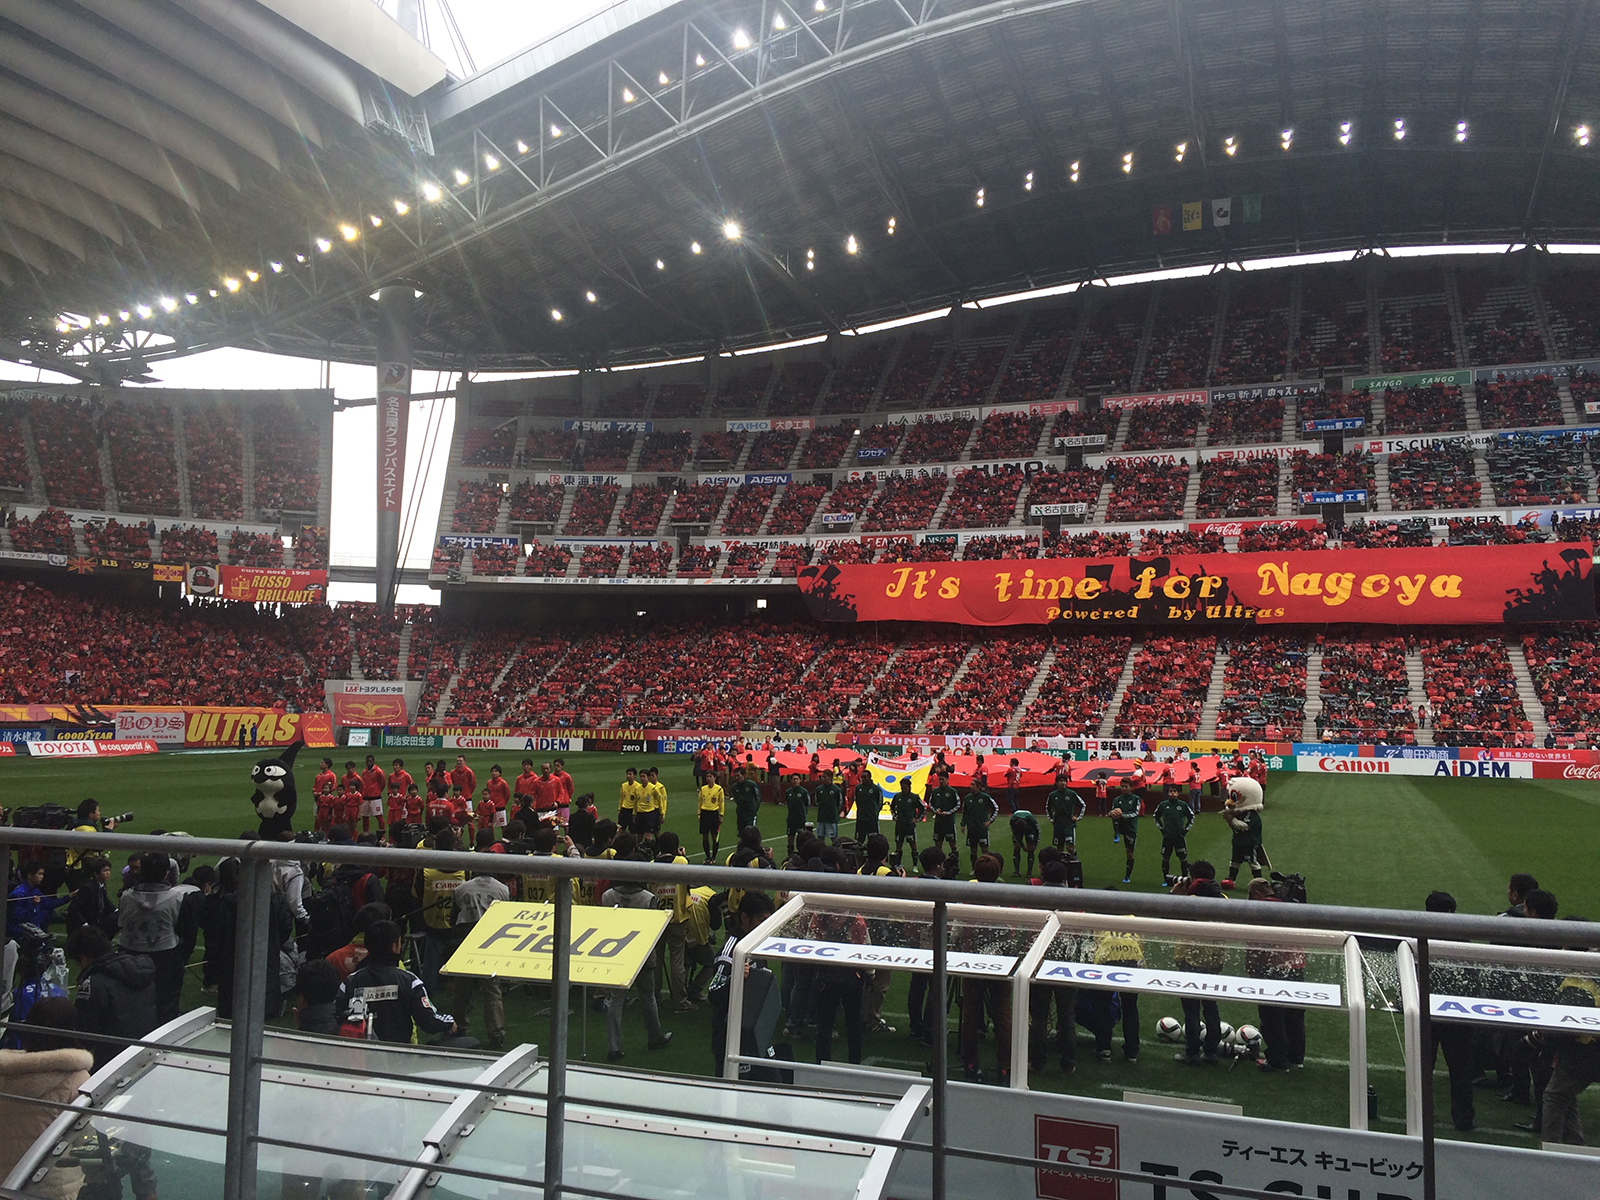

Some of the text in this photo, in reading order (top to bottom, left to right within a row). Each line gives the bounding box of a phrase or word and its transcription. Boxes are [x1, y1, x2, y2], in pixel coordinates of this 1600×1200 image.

[1370, 375, 1455, 389] SANGO SANGO
[571, 421, 611, 431] ASMO
[616, 421, 646, 431] アスモ
[728, 421, 768, 431] TAIHO
[1066, 435, 1105, 446] 名古屋銀行
[1386, 441, 1404, 452] TS
[383, 396, 399, 507] 名古屋グランパスエイト
[564, 475, 618, 487] 東海理化
[702, 476, 741, 487] AISIN
[750, 475, 789, 486] AISIN
[1043, 503, 1085, 514] 名古屋銀行
[823, 514, 854, 523] EXEDY
[1205, 521, 1242, 536] Coca-Cola
[444, 537, 513, 549] アサヒビール
[101, 559, 119, 568] RB
[251, 575, 292, 589] ROSSO
[885, 560, 1463, 607] It's time for Nagoya
[256, 589, 316, 603] BRILLANTE
[1045, 605, 1139, 621] Powered
[1168, 604, 1196, 621] by
[186, 713, 300, 742] ULTRAS
[2, 731, 42, 742] 清水建設
[57, 730, 114, 741] GOODYEAR
[385, 736, 435, 747] 明治安田生命
[884, 737, 930, 746] HINO
[456, 736, 499, 748] Canon
[524, 737, 570, 751] AiDEM
[622, 744, 641, 752] zero
[679, 742, 699, 752] JCB
[953, 737, 1005, 748] TOYOTA
[1067, 740, 1136, 751] 朝日新聞
[34, 743, 92, 754] TOYOTA
[1402, 748, 1450, 760] 豊田通商
[1318, 757, 1390, 773] Canon
[1434, 760, 1510, 778] AiDEM
[434, 881, 461, 889] Cano
[527, 887, 545, 900] 037
[513, 910, 555, 922] RAY
[478, 922, 641, 958] Field
[761, 942, 842, 958] AGC
[847, 952, 920, 965] ASAHI
[466, 958, 613, 976] HAIR&BEUTY
[1045, 966, 1331, 1002] AGC ASAHI GLASS
[1436, 1000, 1541, 1020] AGC
[1221, 1139, 1425, 1182] ティーエス キュービック
